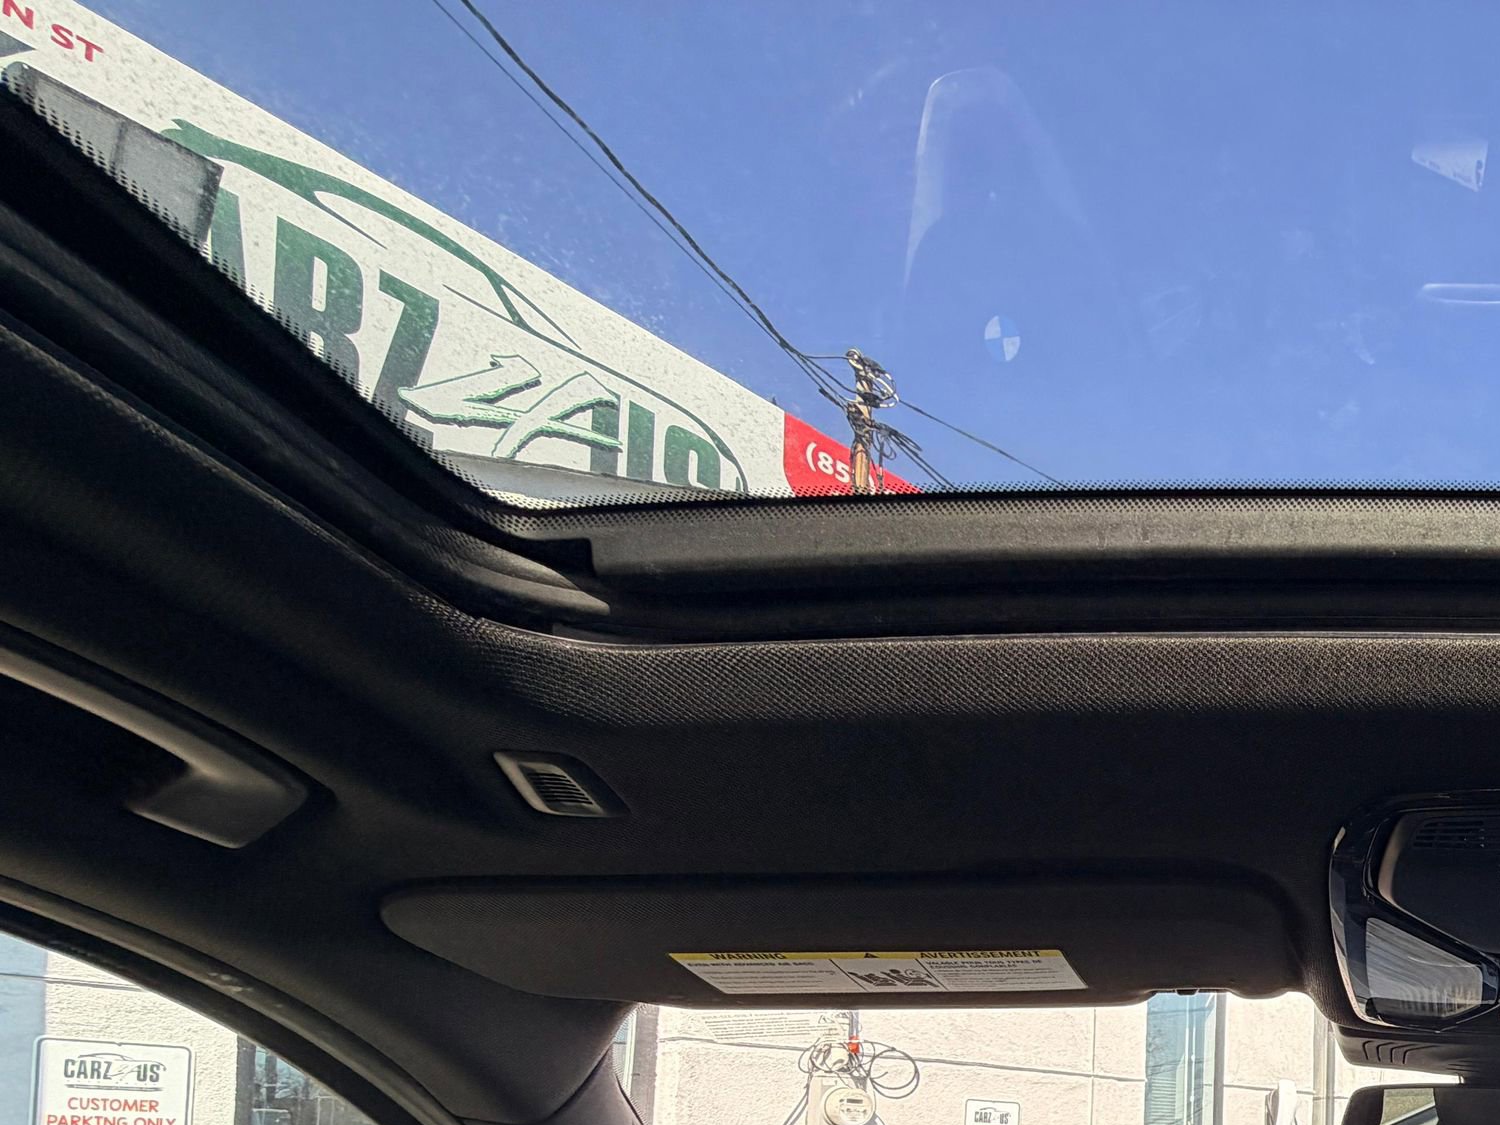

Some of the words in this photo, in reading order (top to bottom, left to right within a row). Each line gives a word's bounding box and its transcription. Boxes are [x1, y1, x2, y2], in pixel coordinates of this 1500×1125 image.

[50, 24, 104, 62] ST
[920, 950, 1042, 959] AVERTISSEMENT
[64, 1058, 112, 1080] CARZ
[136, 1064, 161, 1083] US
[67, 1097, 159, 1113] CUSTOMER
